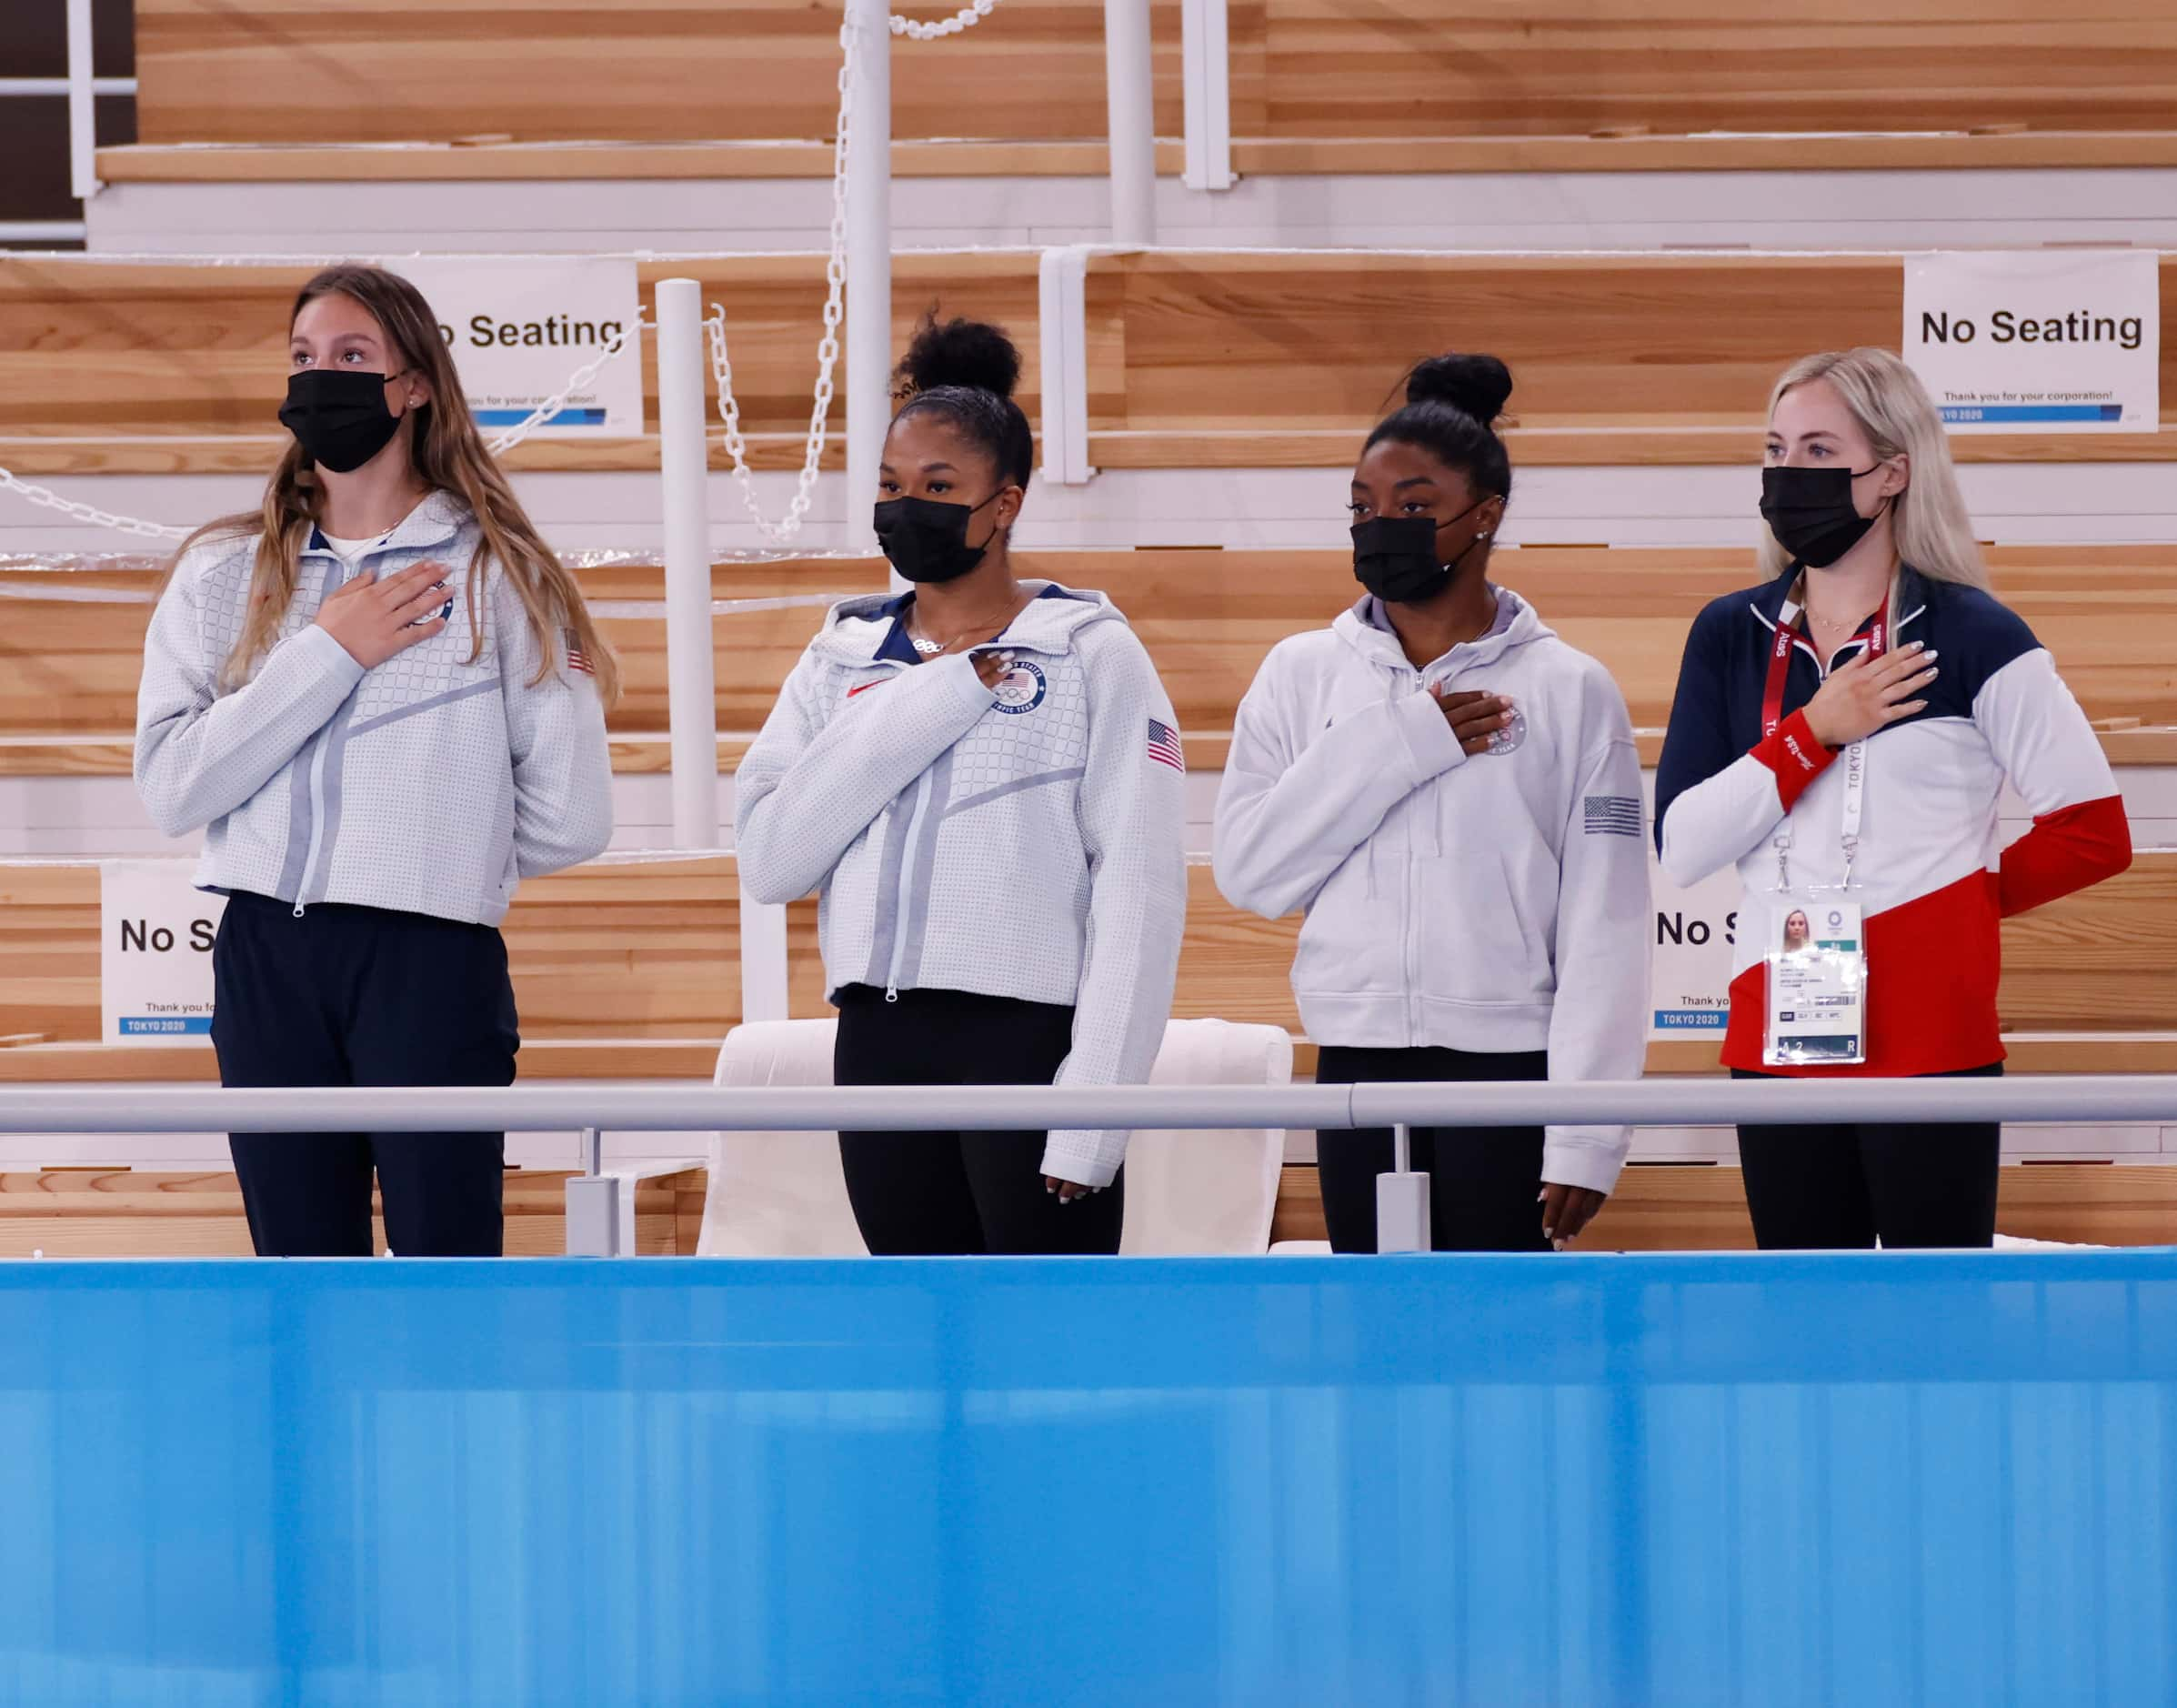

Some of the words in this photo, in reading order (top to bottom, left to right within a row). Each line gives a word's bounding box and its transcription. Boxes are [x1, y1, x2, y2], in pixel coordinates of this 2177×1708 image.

[469, 315, 623, 353] Seating
[1921, 311, 1976, 344] No
[1991, 310, 2142, 350] Seating
[487, 395, 502, 406] for
[505, 397, 528, 407] your
[1944, 391, 1977, 402] Thank
[1979, 394, 2001, 404] you
[2002, 391, 2017, 402] for
[2019, 394, 2044, 404] your
[2046, 391, 2113, 404] corporation!
[1959, 409, 1983, 420] 2020
[1848, 746, 1862, 789] TOKYO
[1657, 911, 1710, 945] No
[121, 919, 175, 952] No
[1680, 996, 1714, 1006] Thank
[146, 1002, 179, 1012] Thank
[181, 1004, 203, 1014] you
[127, 1020, 160, 1032] TOKYO
[161, 1020, 186, 1032] 2020
[1663, 1014, 1695, 1025] TOKYO
[1696, 1014, 1720, 1025] 2020
[1847, 1040, 1856, 1053] R
